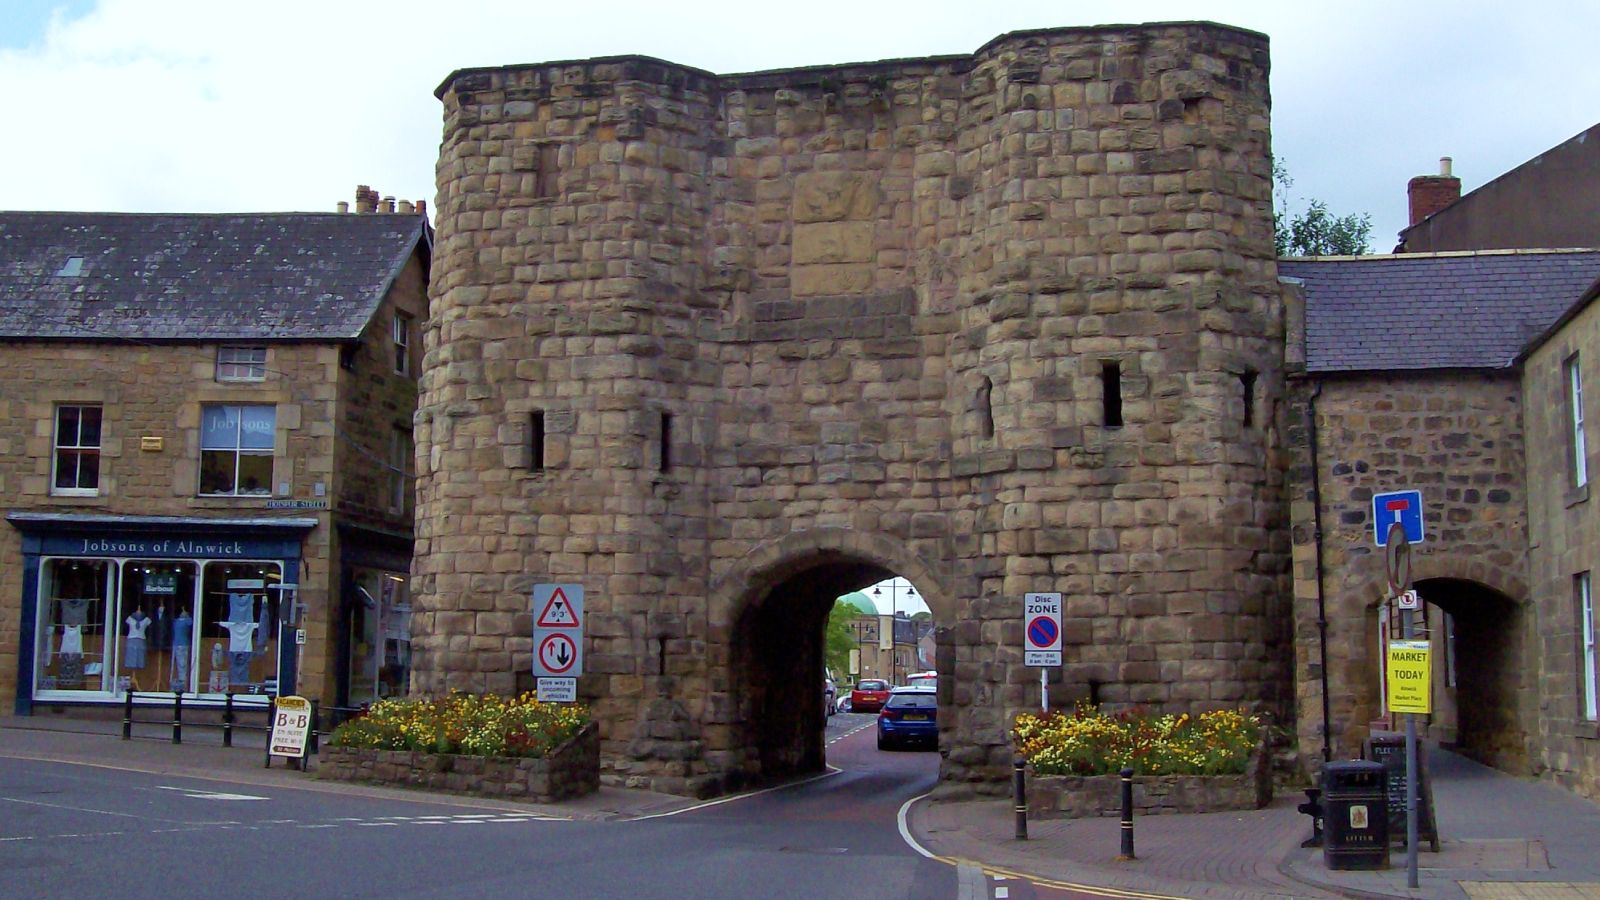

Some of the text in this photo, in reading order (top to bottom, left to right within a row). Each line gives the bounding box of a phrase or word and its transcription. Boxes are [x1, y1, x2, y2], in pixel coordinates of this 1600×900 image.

[82, 539, 242, 554] Jobsons of Alnwick
[1035, 595, 1052, 603] Disc
[1028, 605, 1058, 613] ZONE
[1392, 652, 1427, 662] MARKET
[1394, 670, 1424, 680] TODAY
[278, 714, 287, 726] B
[297, 715, 306, 728] B
